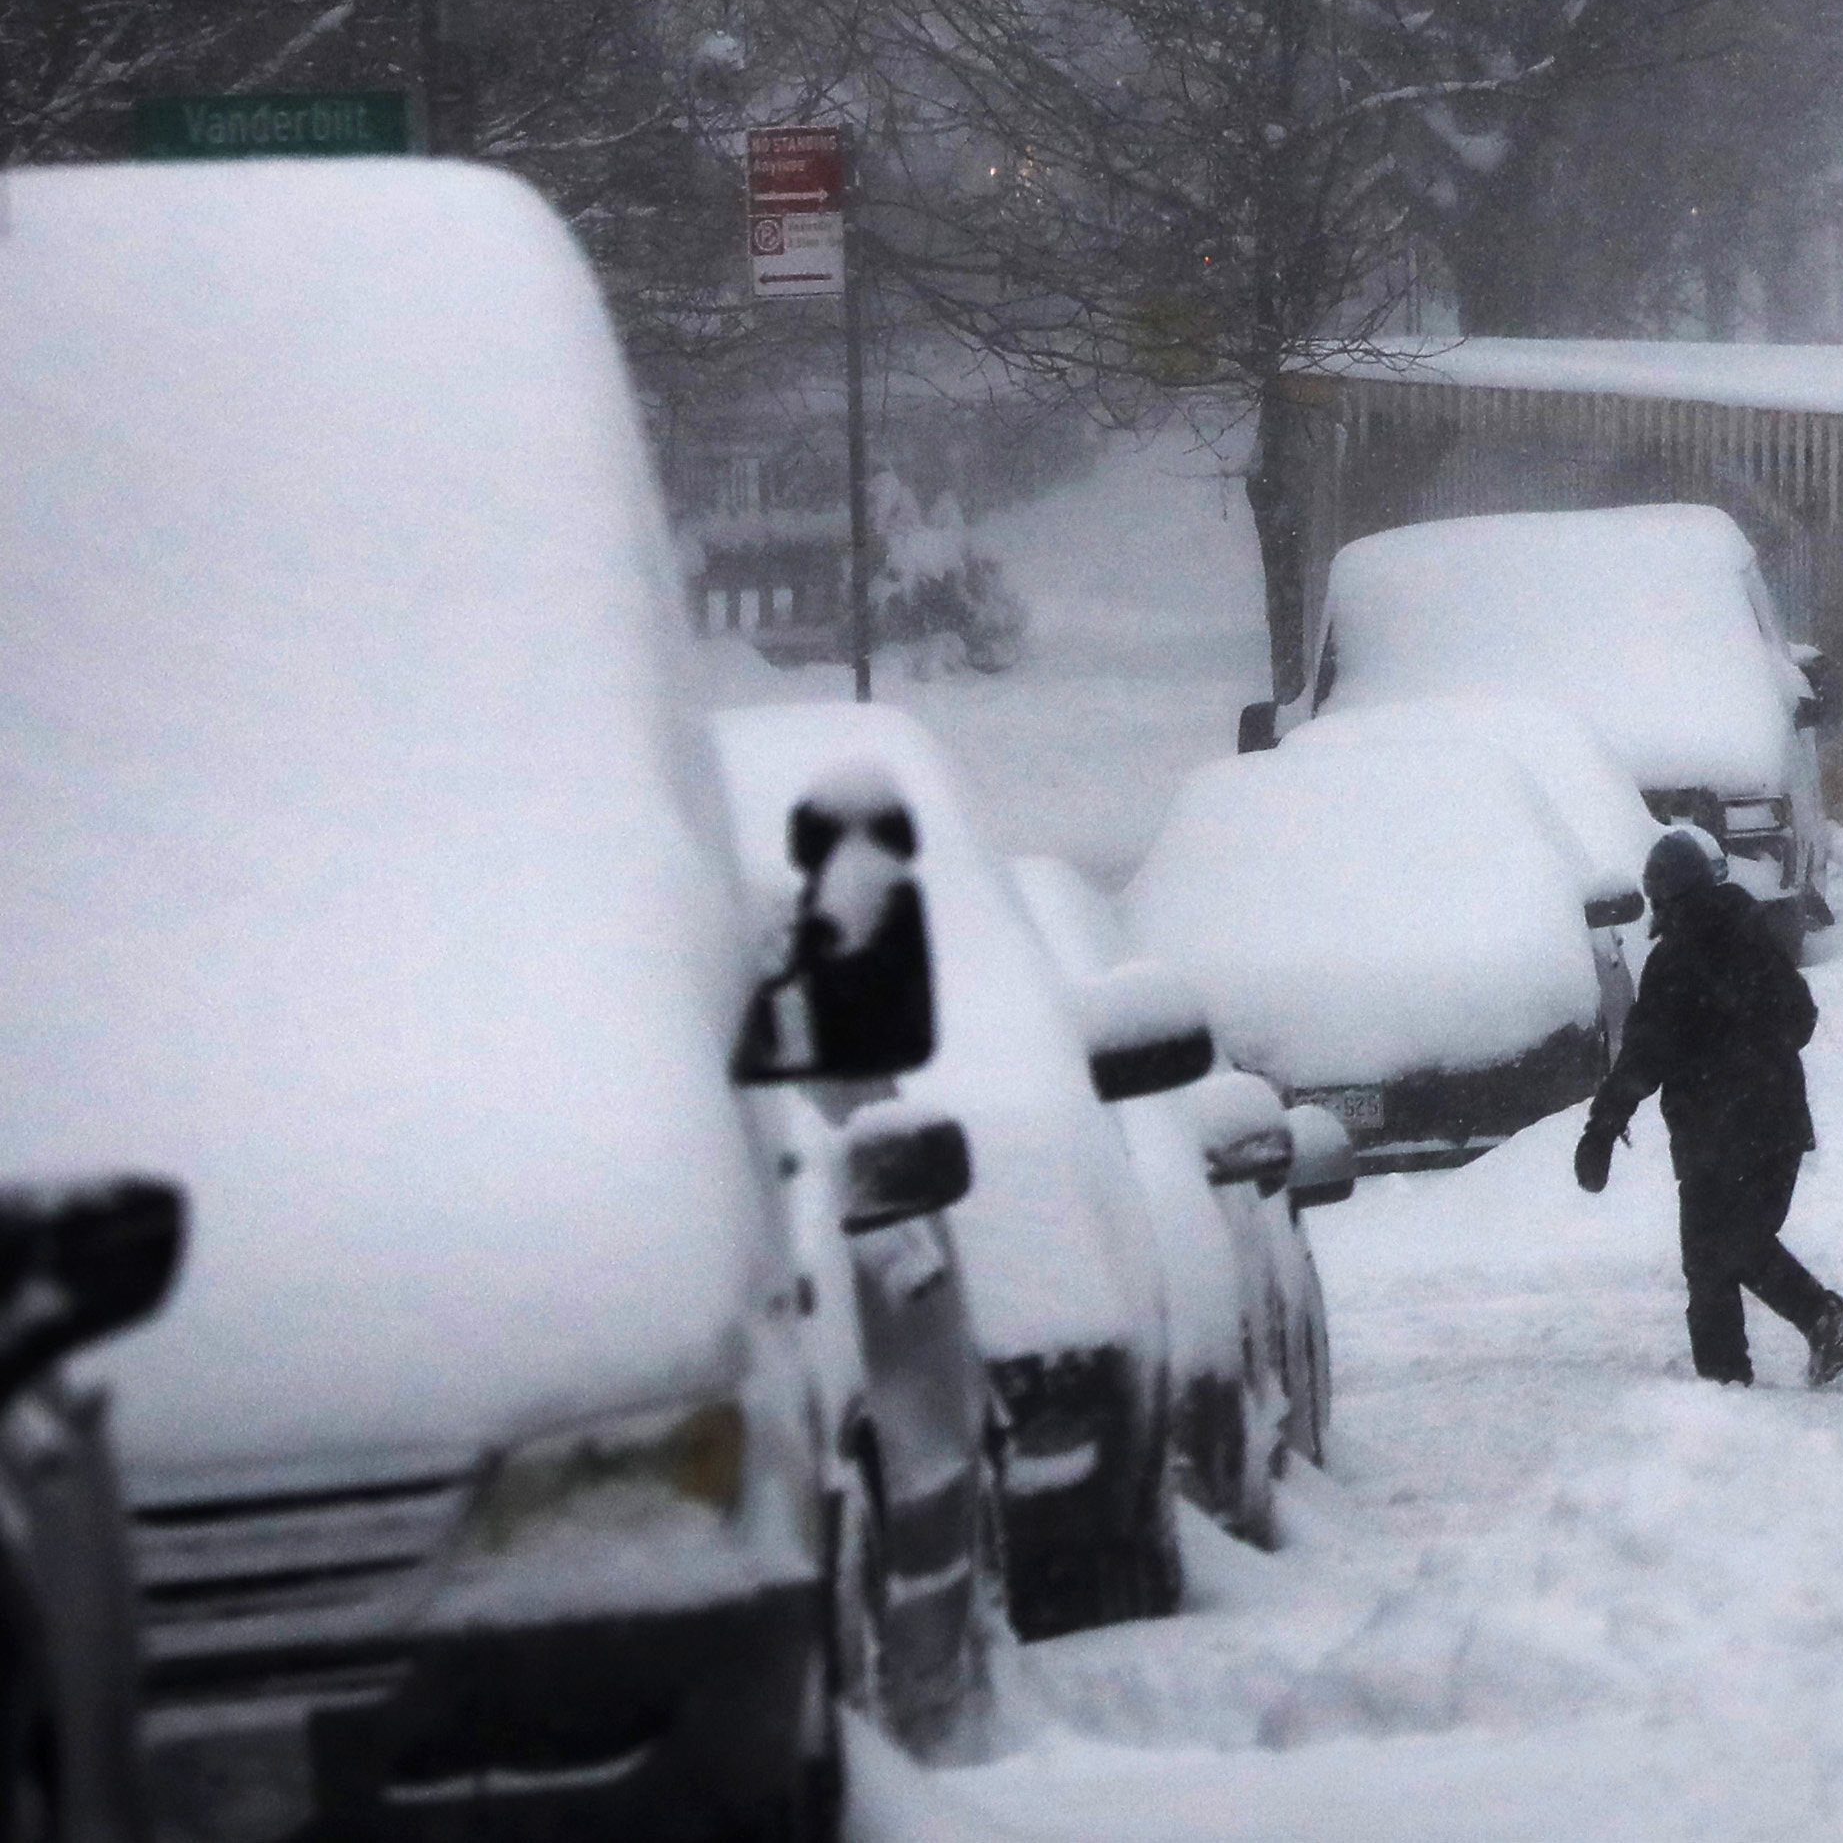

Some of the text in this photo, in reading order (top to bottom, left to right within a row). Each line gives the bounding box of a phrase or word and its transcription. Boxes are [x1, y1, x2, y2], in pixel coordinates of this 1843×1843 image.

[181, 100, 369, 145] Vanderbilt
[752, 135, 838, 152] NO STANDING
